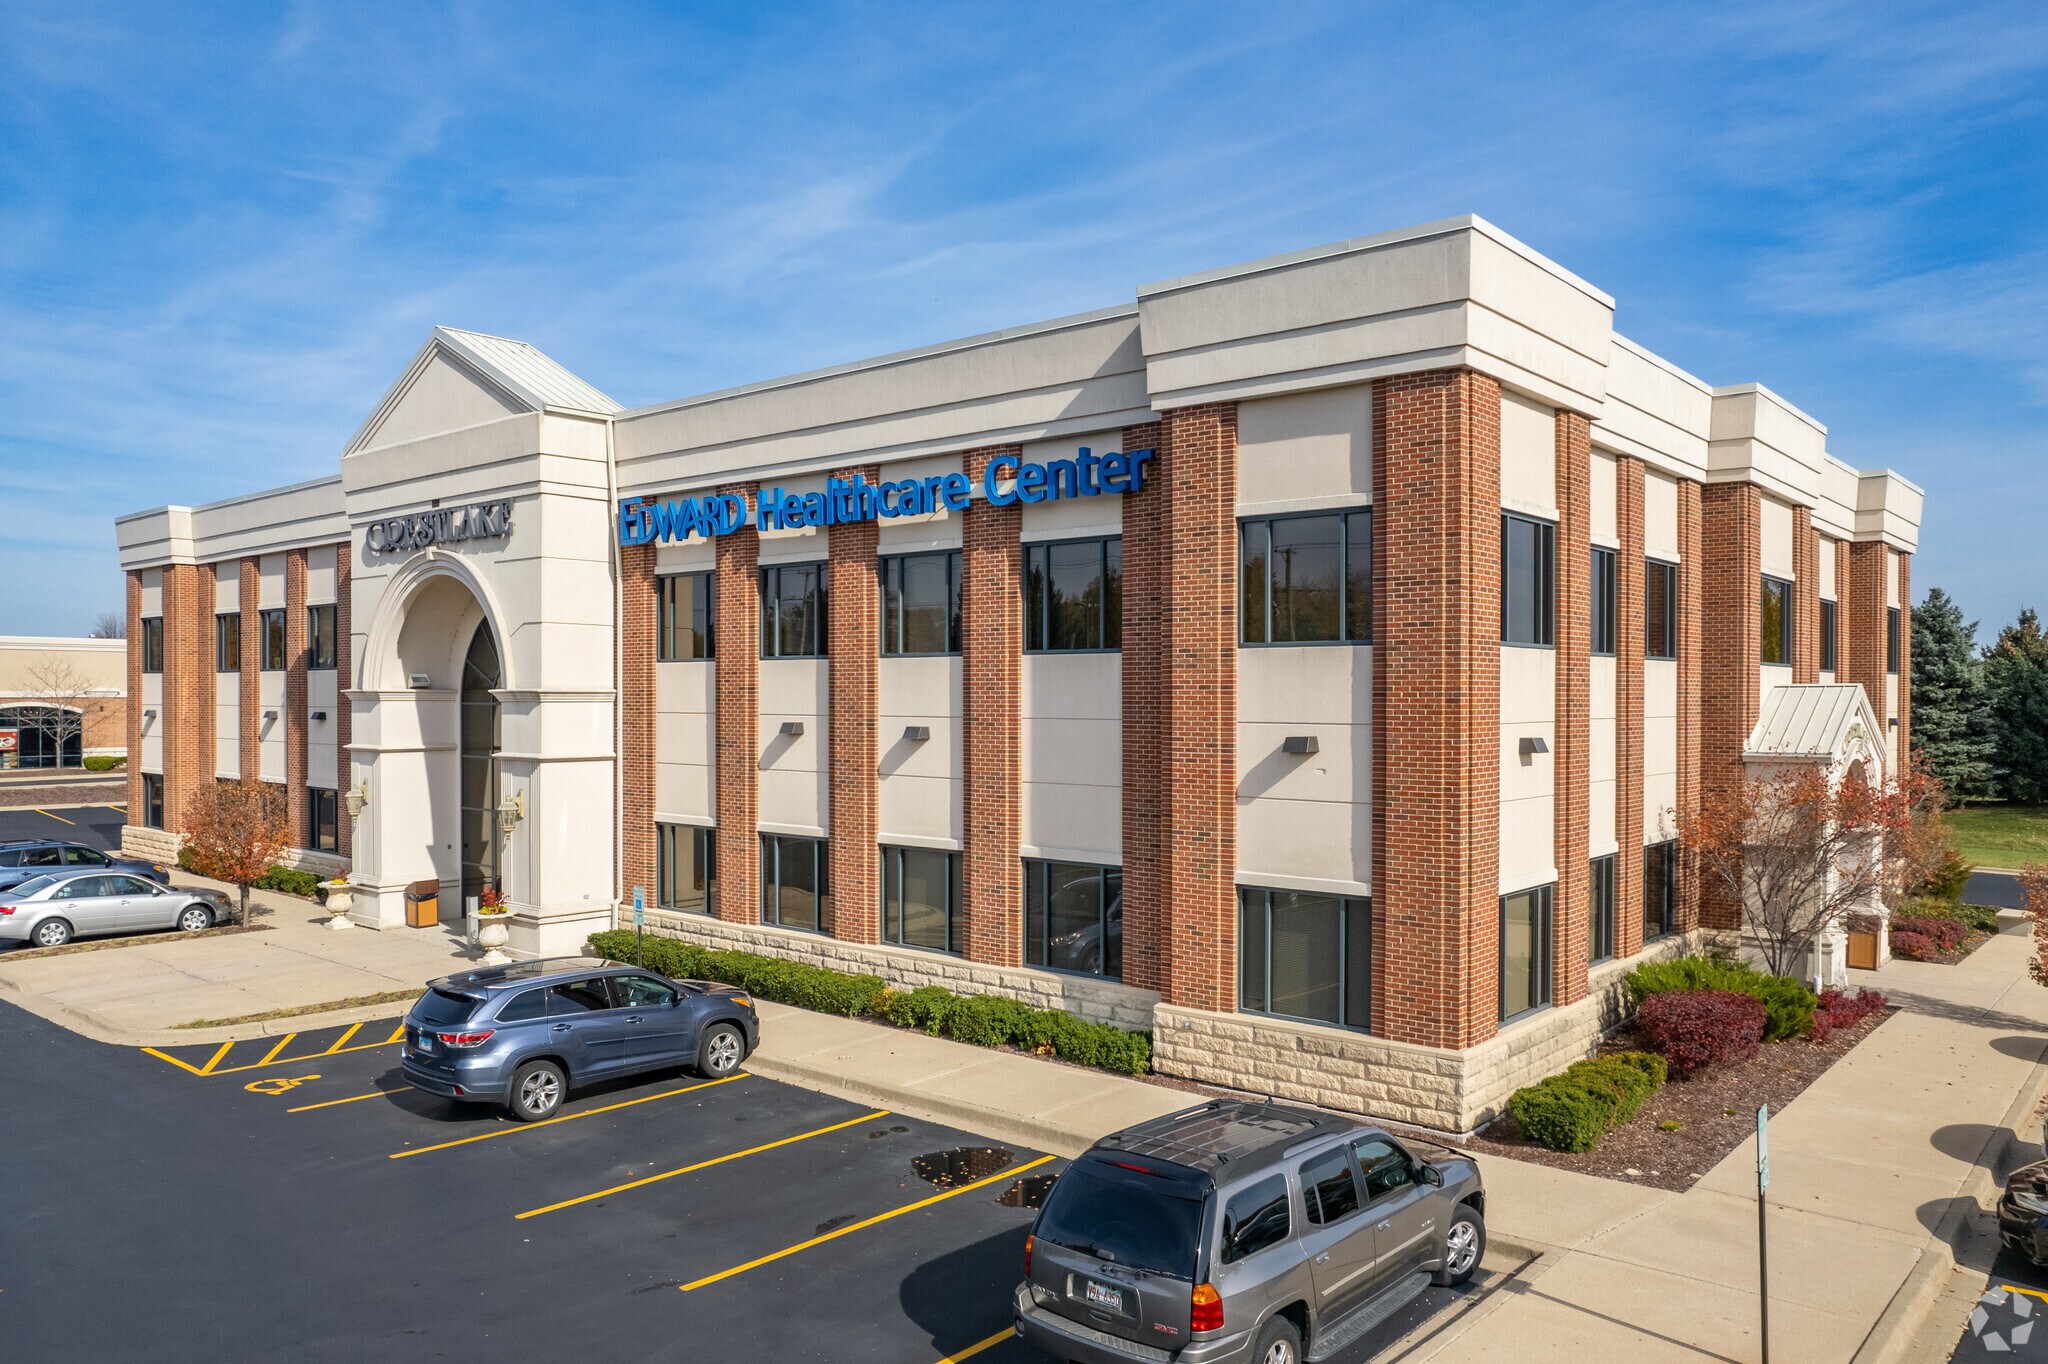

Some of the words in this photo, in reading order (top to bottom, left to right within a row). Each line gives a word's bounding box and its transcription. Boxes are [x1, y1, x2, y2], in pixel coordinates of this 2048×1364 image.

[366, 498, 514, 552] CRESTLAKE
[620, 494, 747, 545] EDWARD
[757, 472, 971, 532] Healthcare
[984, 446, 1156, 507] Center
